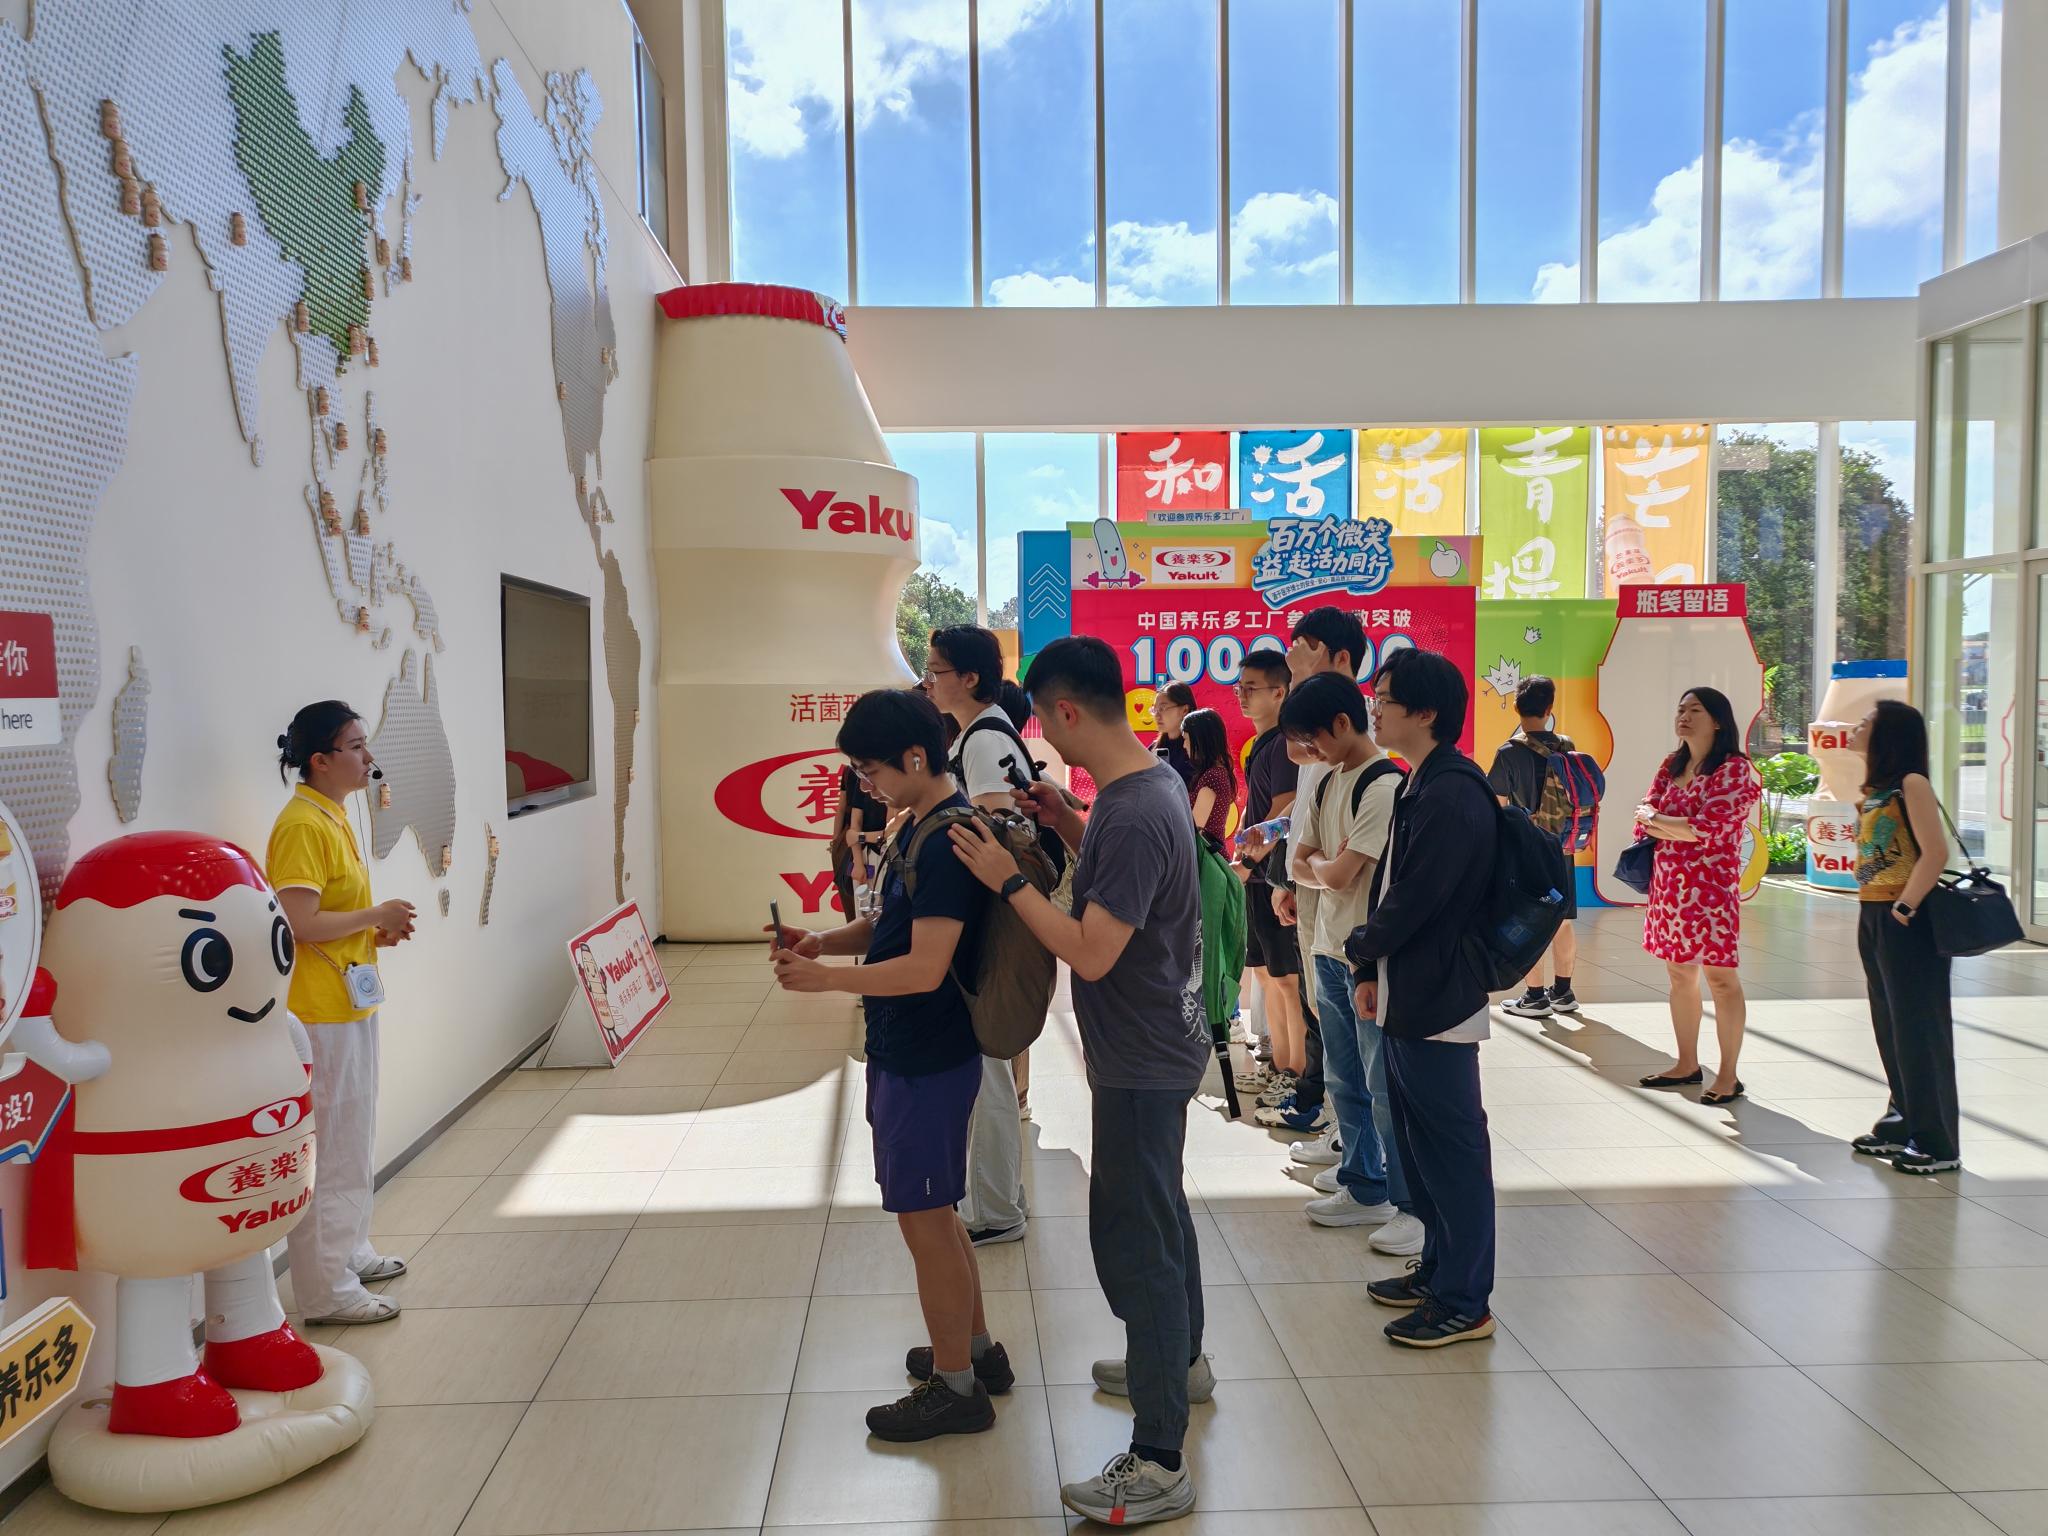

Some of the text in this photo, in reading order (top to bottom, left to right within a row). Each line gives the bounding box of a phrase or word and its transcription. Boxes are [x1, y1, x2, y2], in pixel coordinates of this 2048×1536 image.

[1144, 437, 1222, 504] 和
[1251, 432, 1345, 516] 活
[1374, 431, 1461, 513] 活
[1270, 516, 1387, 554] 百万个微笑
[1168, 571, 1220, 580] Yakult
[1636, 589, 1728, 613] 瓶笺留语
[1138, 609, 1411, 630] 中国养乐多工厂参数突破
[0, 640, 28, 676] 你
[2, 708, 33, 730] here
[605, 948, 638, 984] Yakult
[0, 1092, 33, 1132] 没?
[267, 1104, 290, 1128] Y
